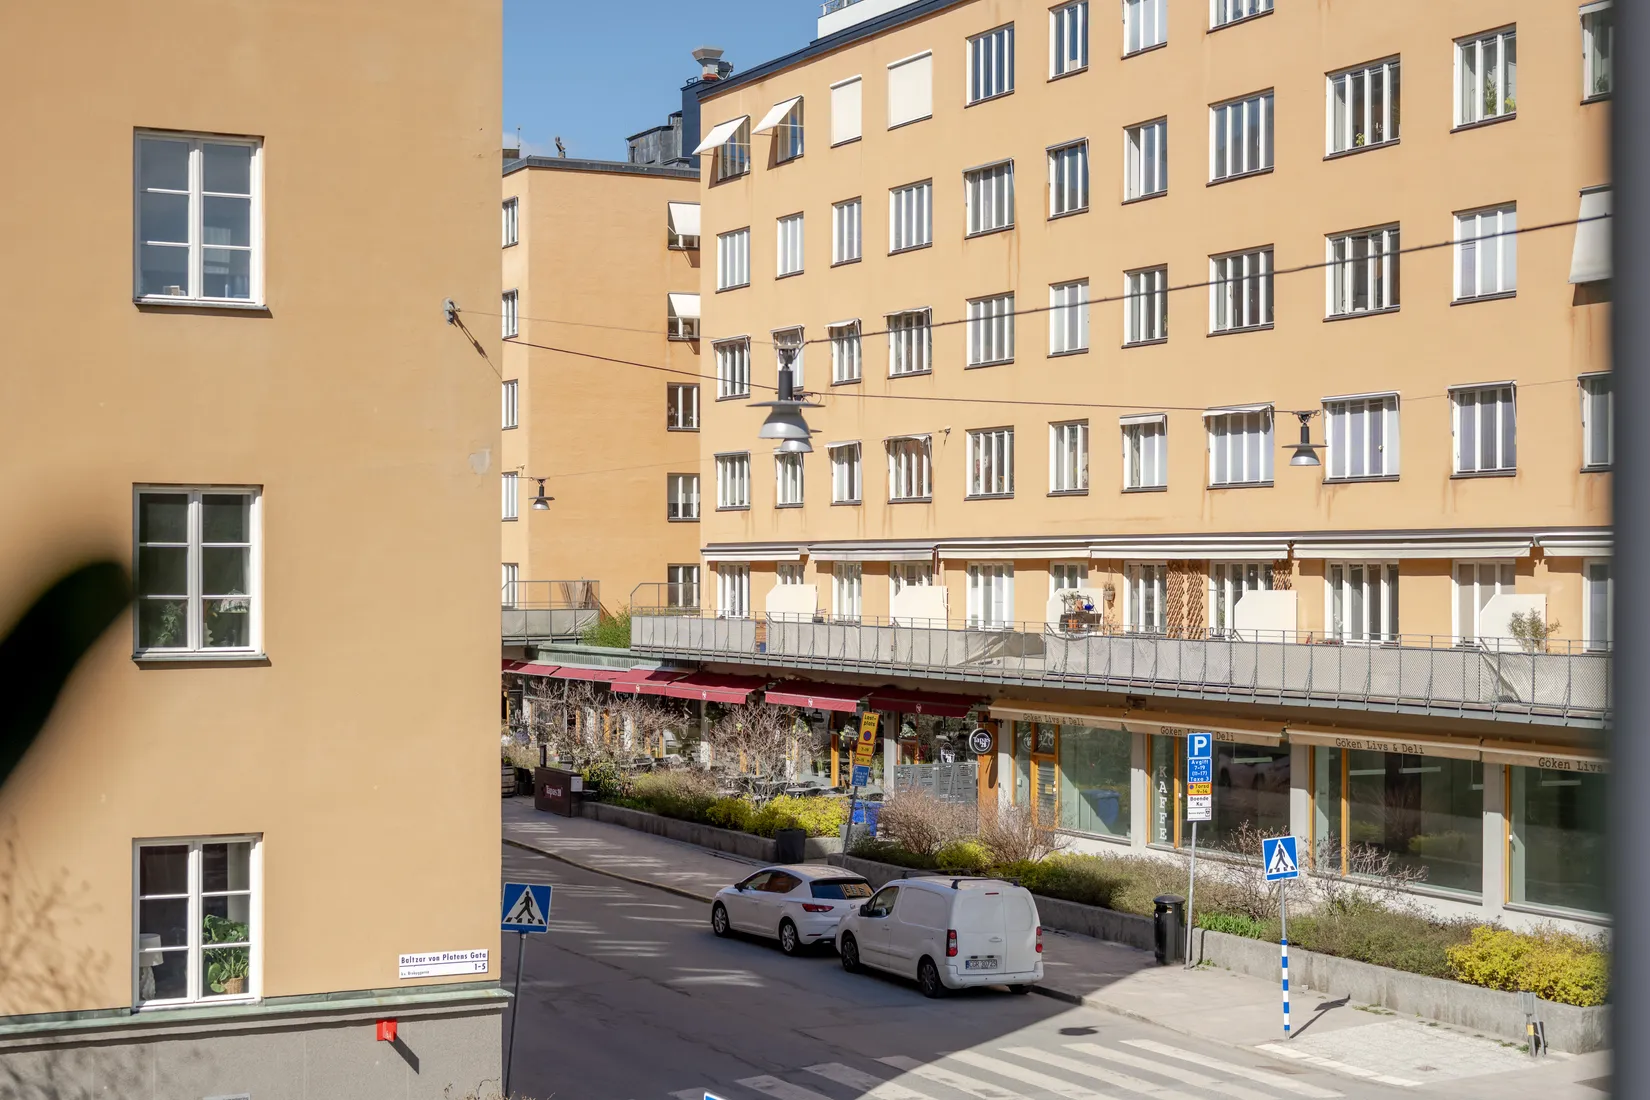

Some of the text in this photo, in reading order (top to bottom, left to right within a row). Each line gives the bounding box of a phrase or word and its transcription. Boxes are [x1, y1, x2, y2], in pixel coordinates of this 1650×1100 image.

[1044, 715, 1059, 724] Livs
[1069, 717, 1084, 726] Deli
[1042, 729, 1054, 746] 28
[1216, 731, 1234, 741] Deli
[1194, 736, 1207, 756] P
[1335, 738, 1424, 754] Göken Livs & Deli
[1539, 757, 1603, 772] Göken Livs
[1159, 766, 1168, 840] KAFFE
[401, 955, 426, 964] Baltzar
[442, 953, 468, 961] Platens
